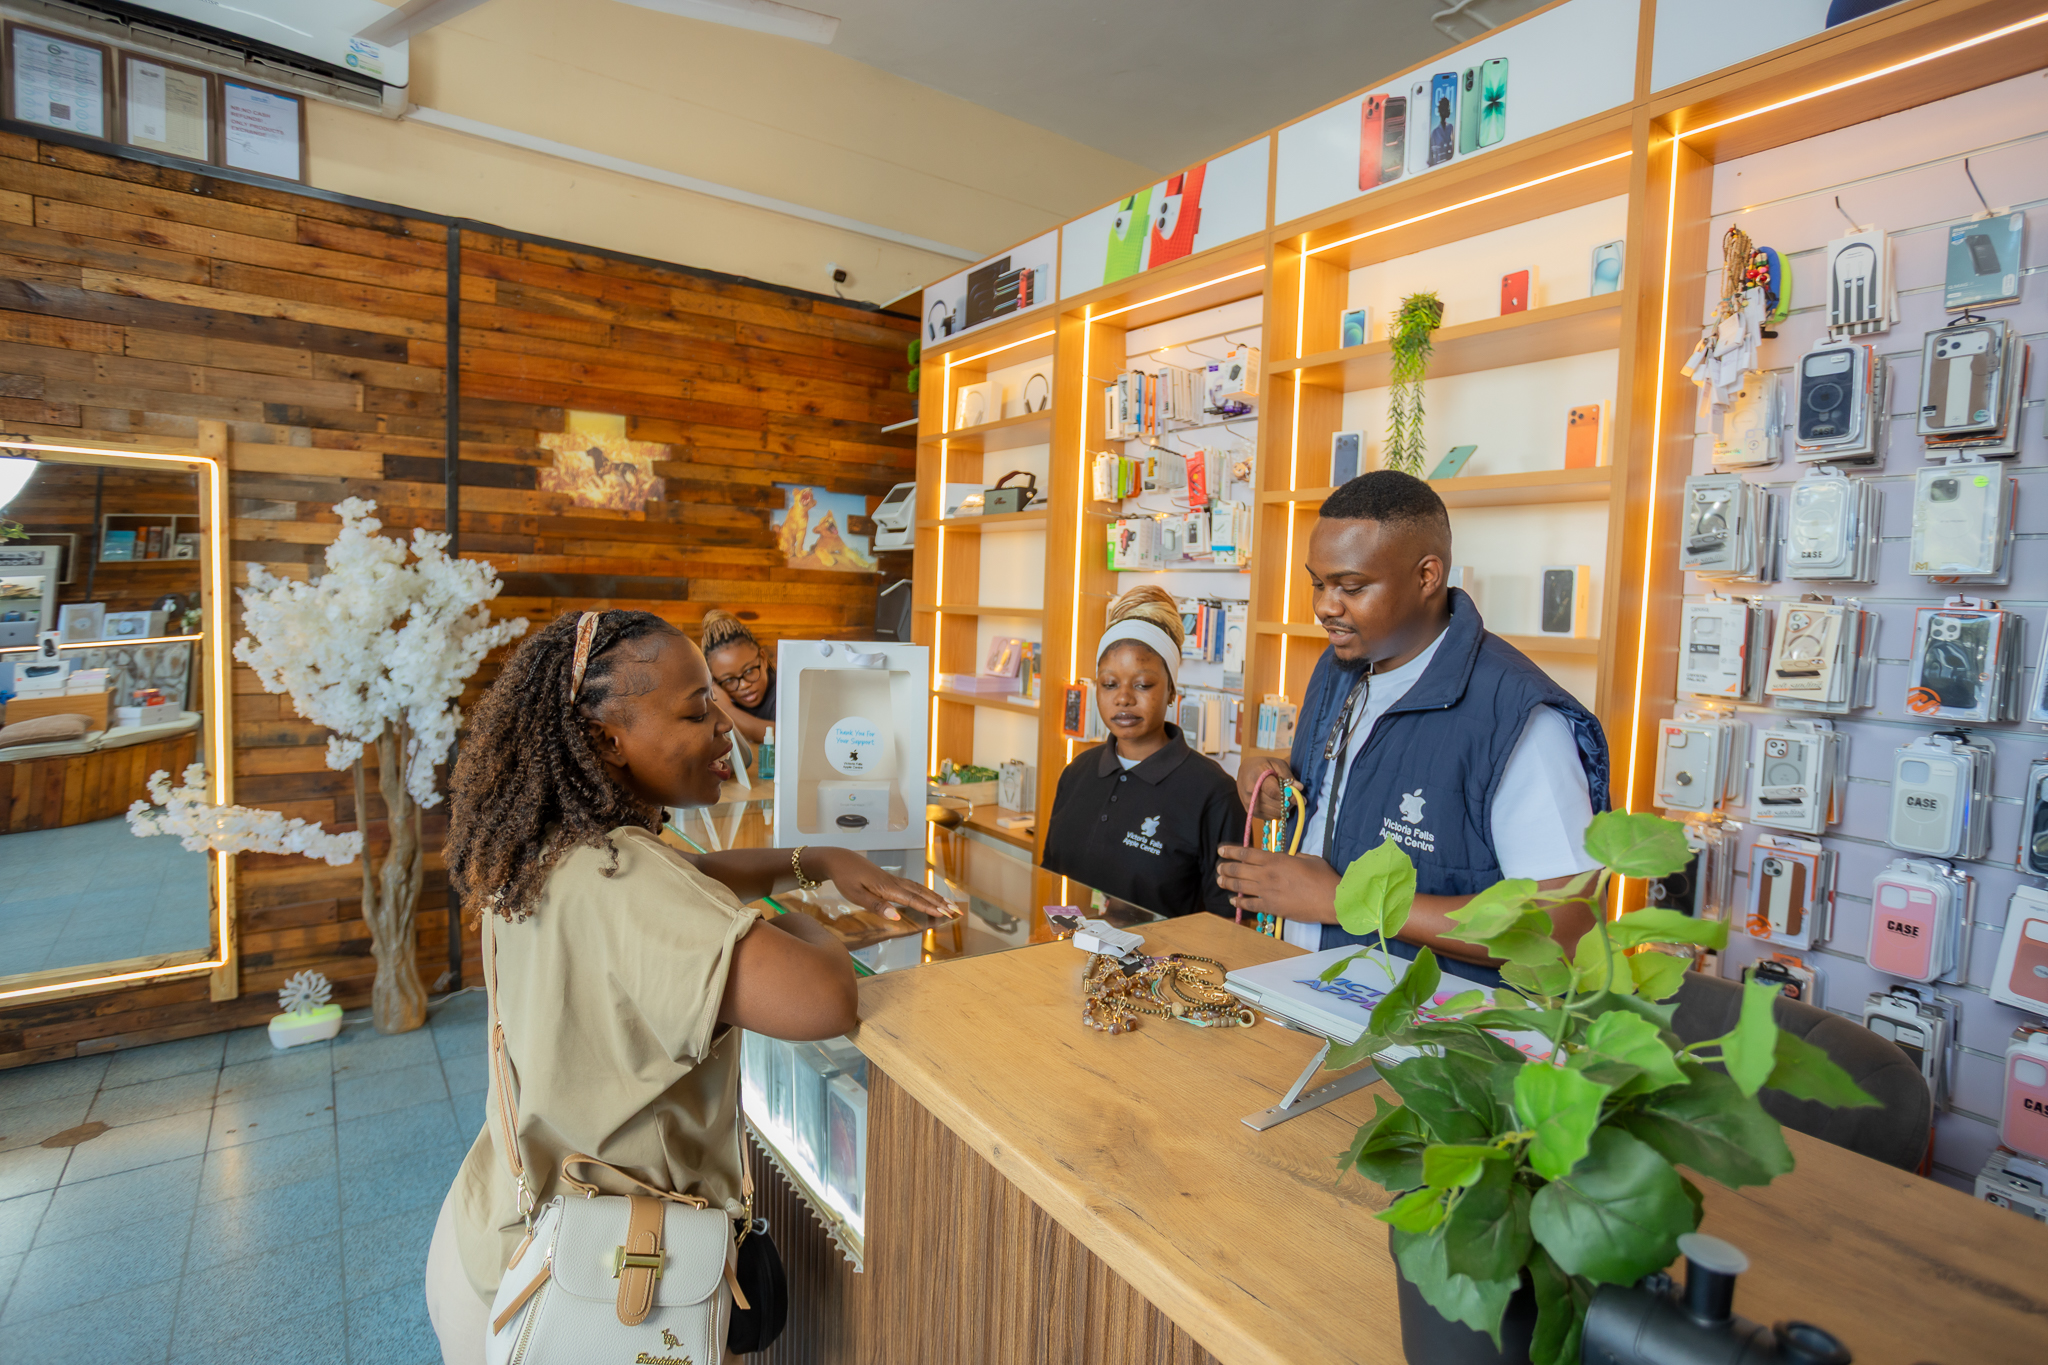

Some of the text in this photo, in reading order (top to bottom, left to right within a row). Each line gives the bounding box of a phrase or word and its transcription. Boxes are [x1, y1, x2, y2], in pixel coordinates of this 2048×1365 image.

[230, 119, 248, 127] ONLY
[1812, 427, 1835, 436] CASE
[1801, 550, 1823, 559] CASE
[836, 728, 853, 736] Thank
[855, 729, 865, 737] You
[851, 738, 875, 746] Support
[1906, 796, 1937, 809] CASE
[1383, 817, 1435, 842] Victoria Falls
[1122, 837, 1161, 855] Apple Centre
[1127, 831, 1163, 849] Victoria Falls
[1404, 836, 1435, 852] Centre
[1887, 920, 1920, 937] CASE
